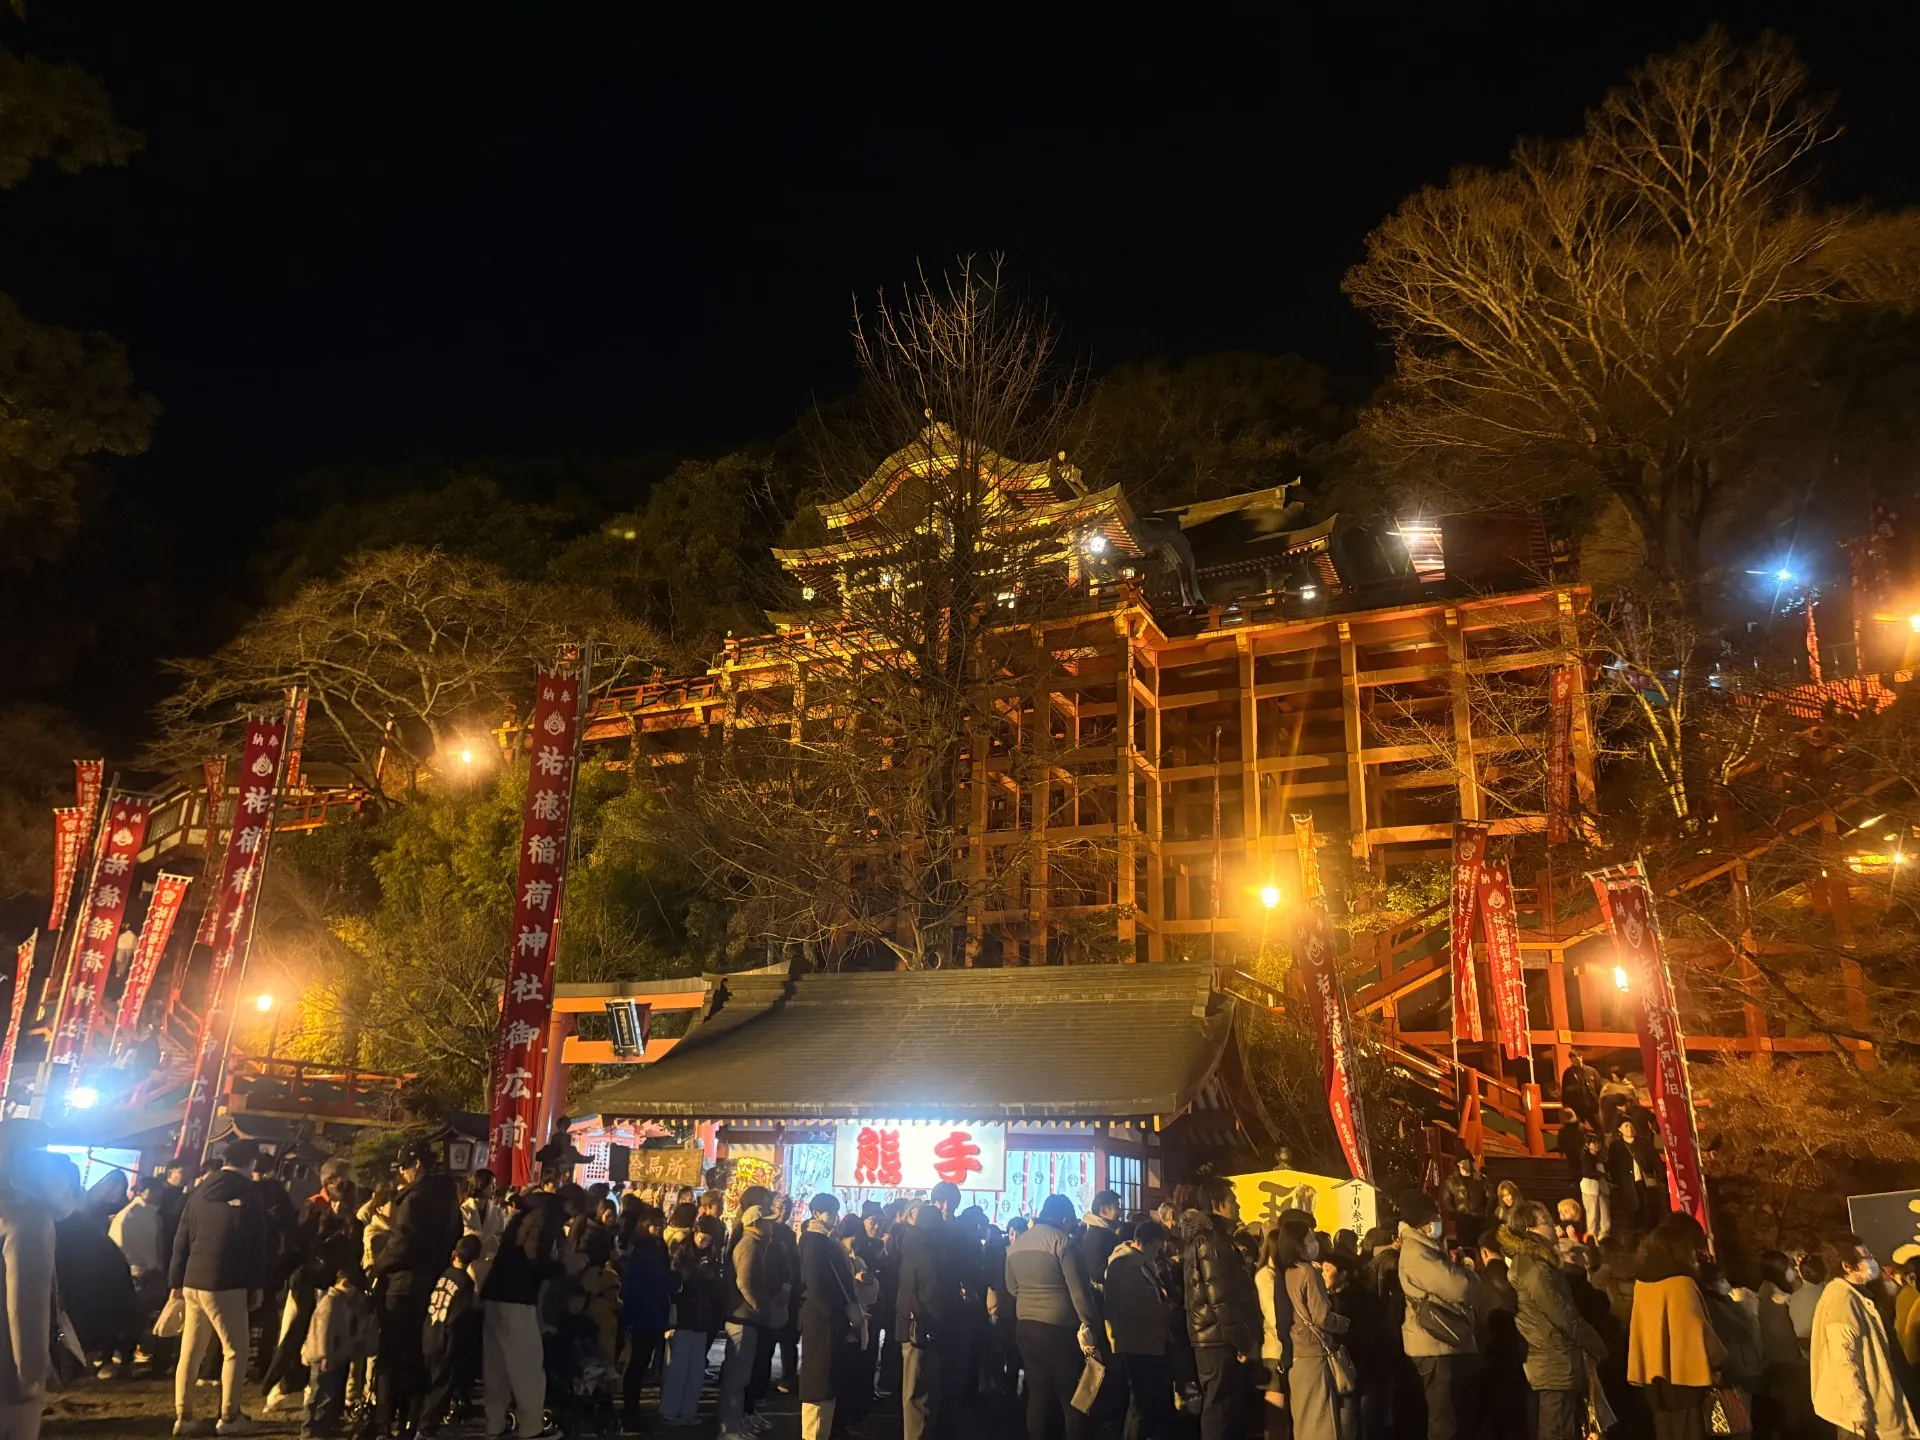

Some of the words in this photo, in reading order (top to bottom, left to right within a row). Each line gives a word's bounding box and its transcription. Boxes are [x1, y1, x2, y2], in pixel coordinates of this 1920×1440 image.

[500, 745, 565, 1150] 祐徳稲荷神社御広前
[855, 1126, 983, 1185] 熊手
[1350, 1183, 1365, 1238] 下り参道
